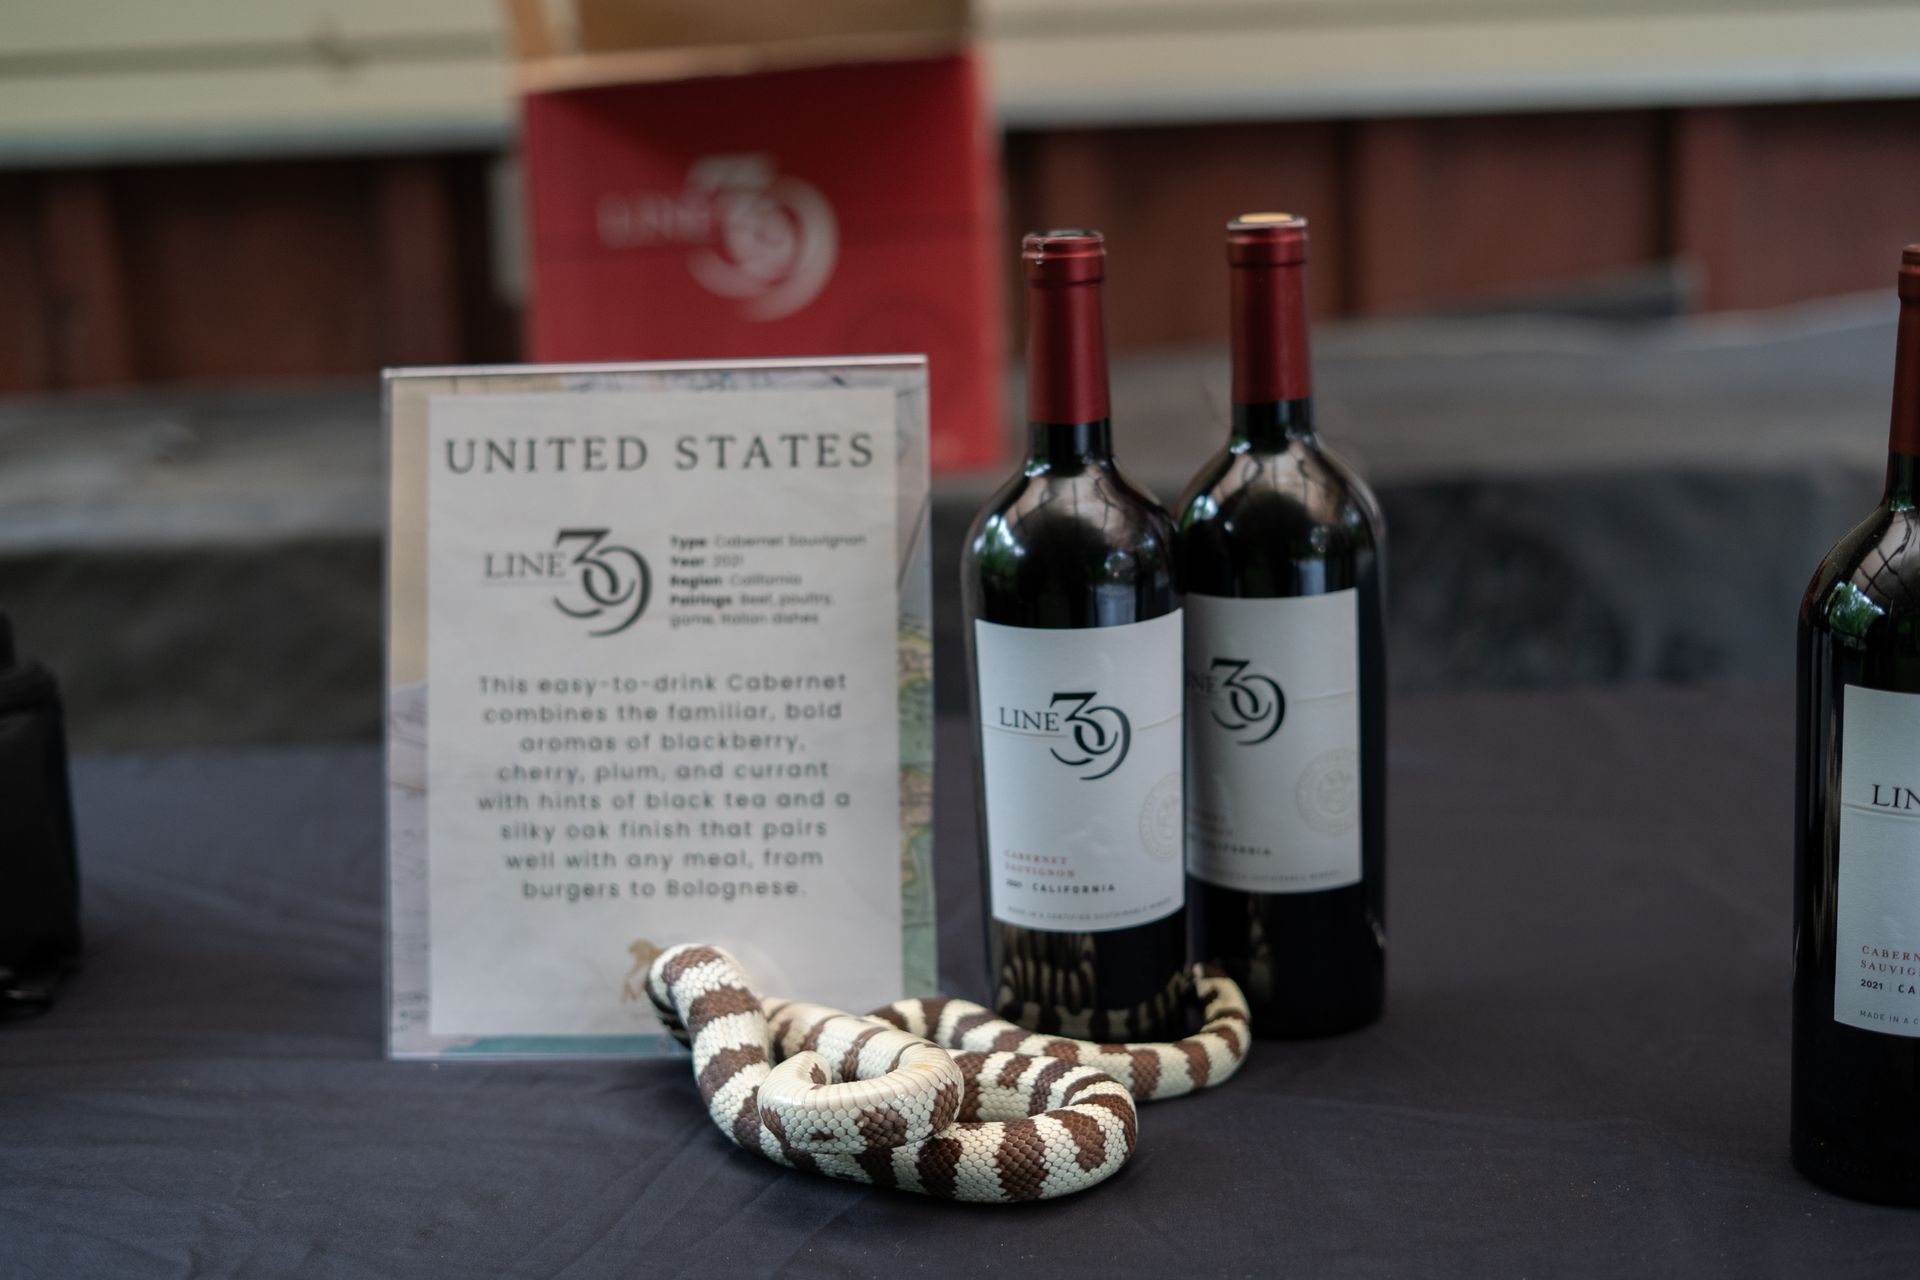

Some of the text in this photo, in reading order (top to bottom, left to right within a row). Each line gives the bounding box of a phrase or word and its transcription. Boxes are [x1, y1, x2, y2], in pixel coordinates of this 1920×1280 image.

[446, 432, 873, 474] UNITED STATES
[714, 534, 783, 547] Cabernet
[788, 533, 866, 550] Sauvignon
[485, 527, 652, 637] LINE 39
[730, 574, 802, 586] California
[772, 612, 818, 624] dishes
[480, 672, 847, 697] This easy-to-drink Cabernet
[483, 701, 842, 723] combines the familiar, bold
[1210, 657, 1285, 745] 39
[520, 731, 806, 754] aromas of blackberry,
[1000, 691, 1131, 781] LINE 39
[497, 759, 829, 784] cherry, plum, and currant
[478, 789, 851, 811] with hints of black tea and a
[1872, 783, 1920, 809] LIN
[500, 819, 828, 843] silky oak finish that pairs
[505, 847, 823, 873] well with any meal, from
[1004, 849, 1067, 865] CABERNET
[1004, 861, 1075, 878] SAUVIGNON
[522, 878, 806, 904] burgers to Bolognese.
[1032, 882, 1116, 895] CALIFORNIA
[1862, 945, 1920, 961] CABERN
[1860, 959, 1920, 976] SAUVIG
[1860, 978, 1883, 991] 2021
[1859, 1009, 1885, 1022] MADE
[1889, 1015, 1899, 1023] IN
[1903, 1017, 1909, 1025] A
